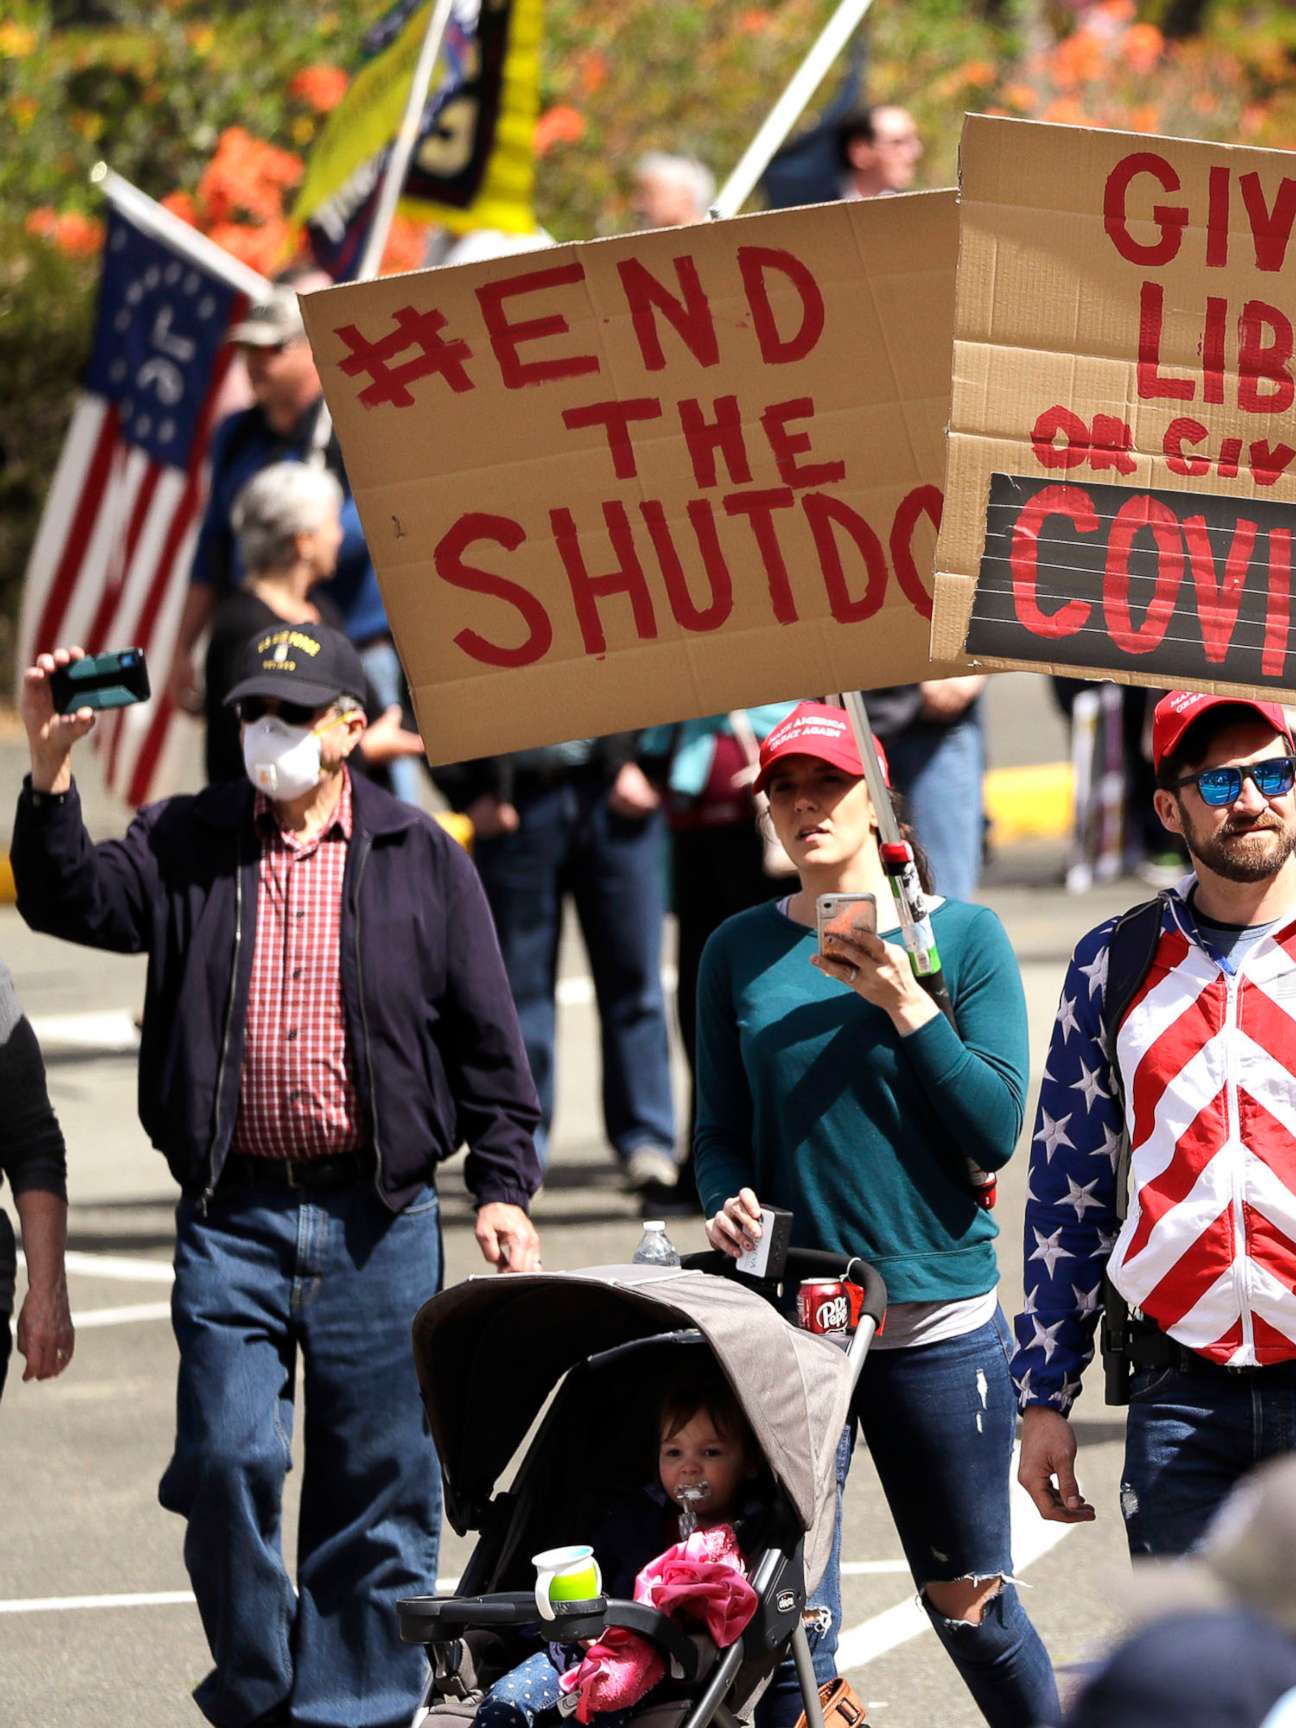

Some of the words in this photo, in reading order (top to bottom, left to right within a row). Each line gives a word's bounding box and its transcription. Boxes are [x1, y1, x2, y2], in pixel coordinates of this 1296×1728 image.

[333, 245, 825, 408] #END
[561, 396, 846, 490] THE
[1030, 405, 1136, 475] OR
[801, 726, 842, 738] AGAIN
